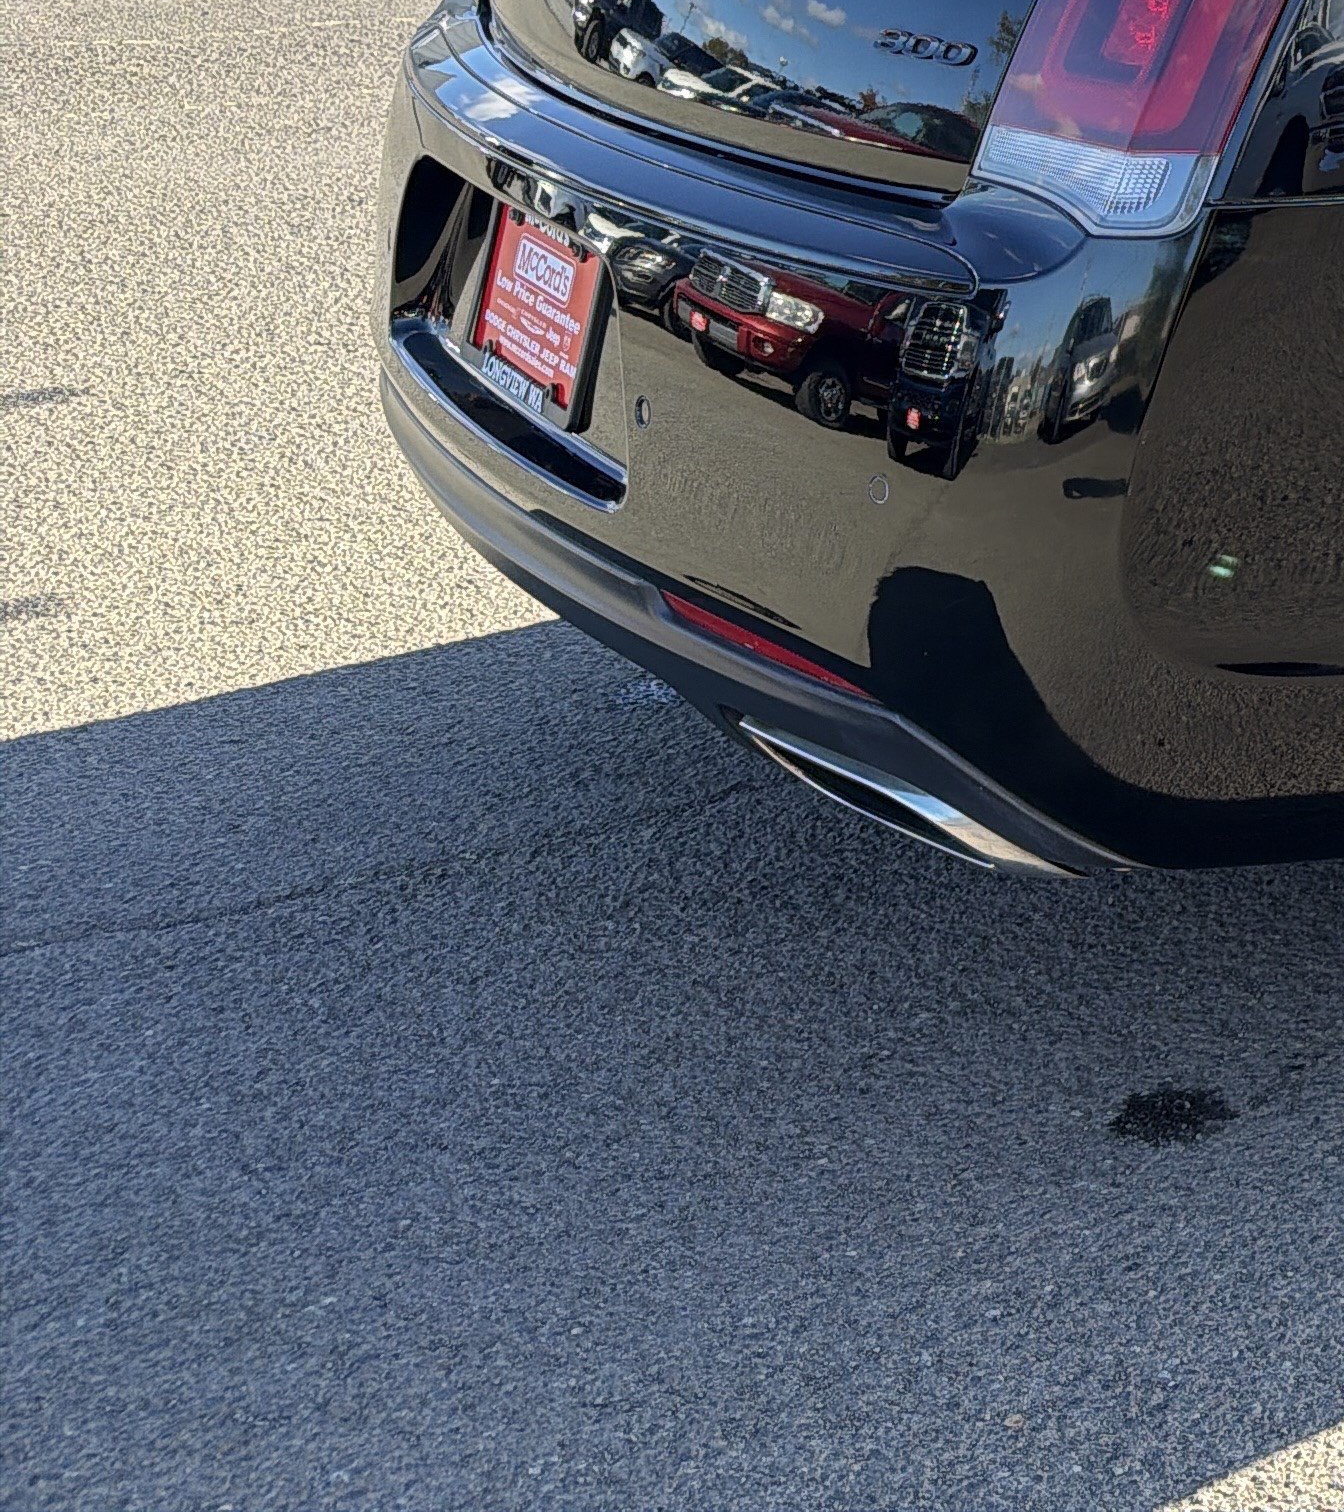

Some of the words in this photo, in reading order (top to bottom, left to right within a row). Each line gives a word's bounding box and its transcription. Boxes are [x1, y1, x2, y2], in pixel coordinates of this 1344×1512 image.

[873, 28, 979, 67] 300
[518, 243, 569, 296] McCord's
[496, 269, 513, 292] Low
[513, 280, 535, 306] Price
[536, 295, 581, 336] Guarantee
[484, 308, 507, 332] DODGE
[506, 324, 541, 356] CHRYSLER
[540, 347, 559, 367] JEEP
[481, 351, 530, 401] LONGVIEW
[529, 383, 544, 413] WA
